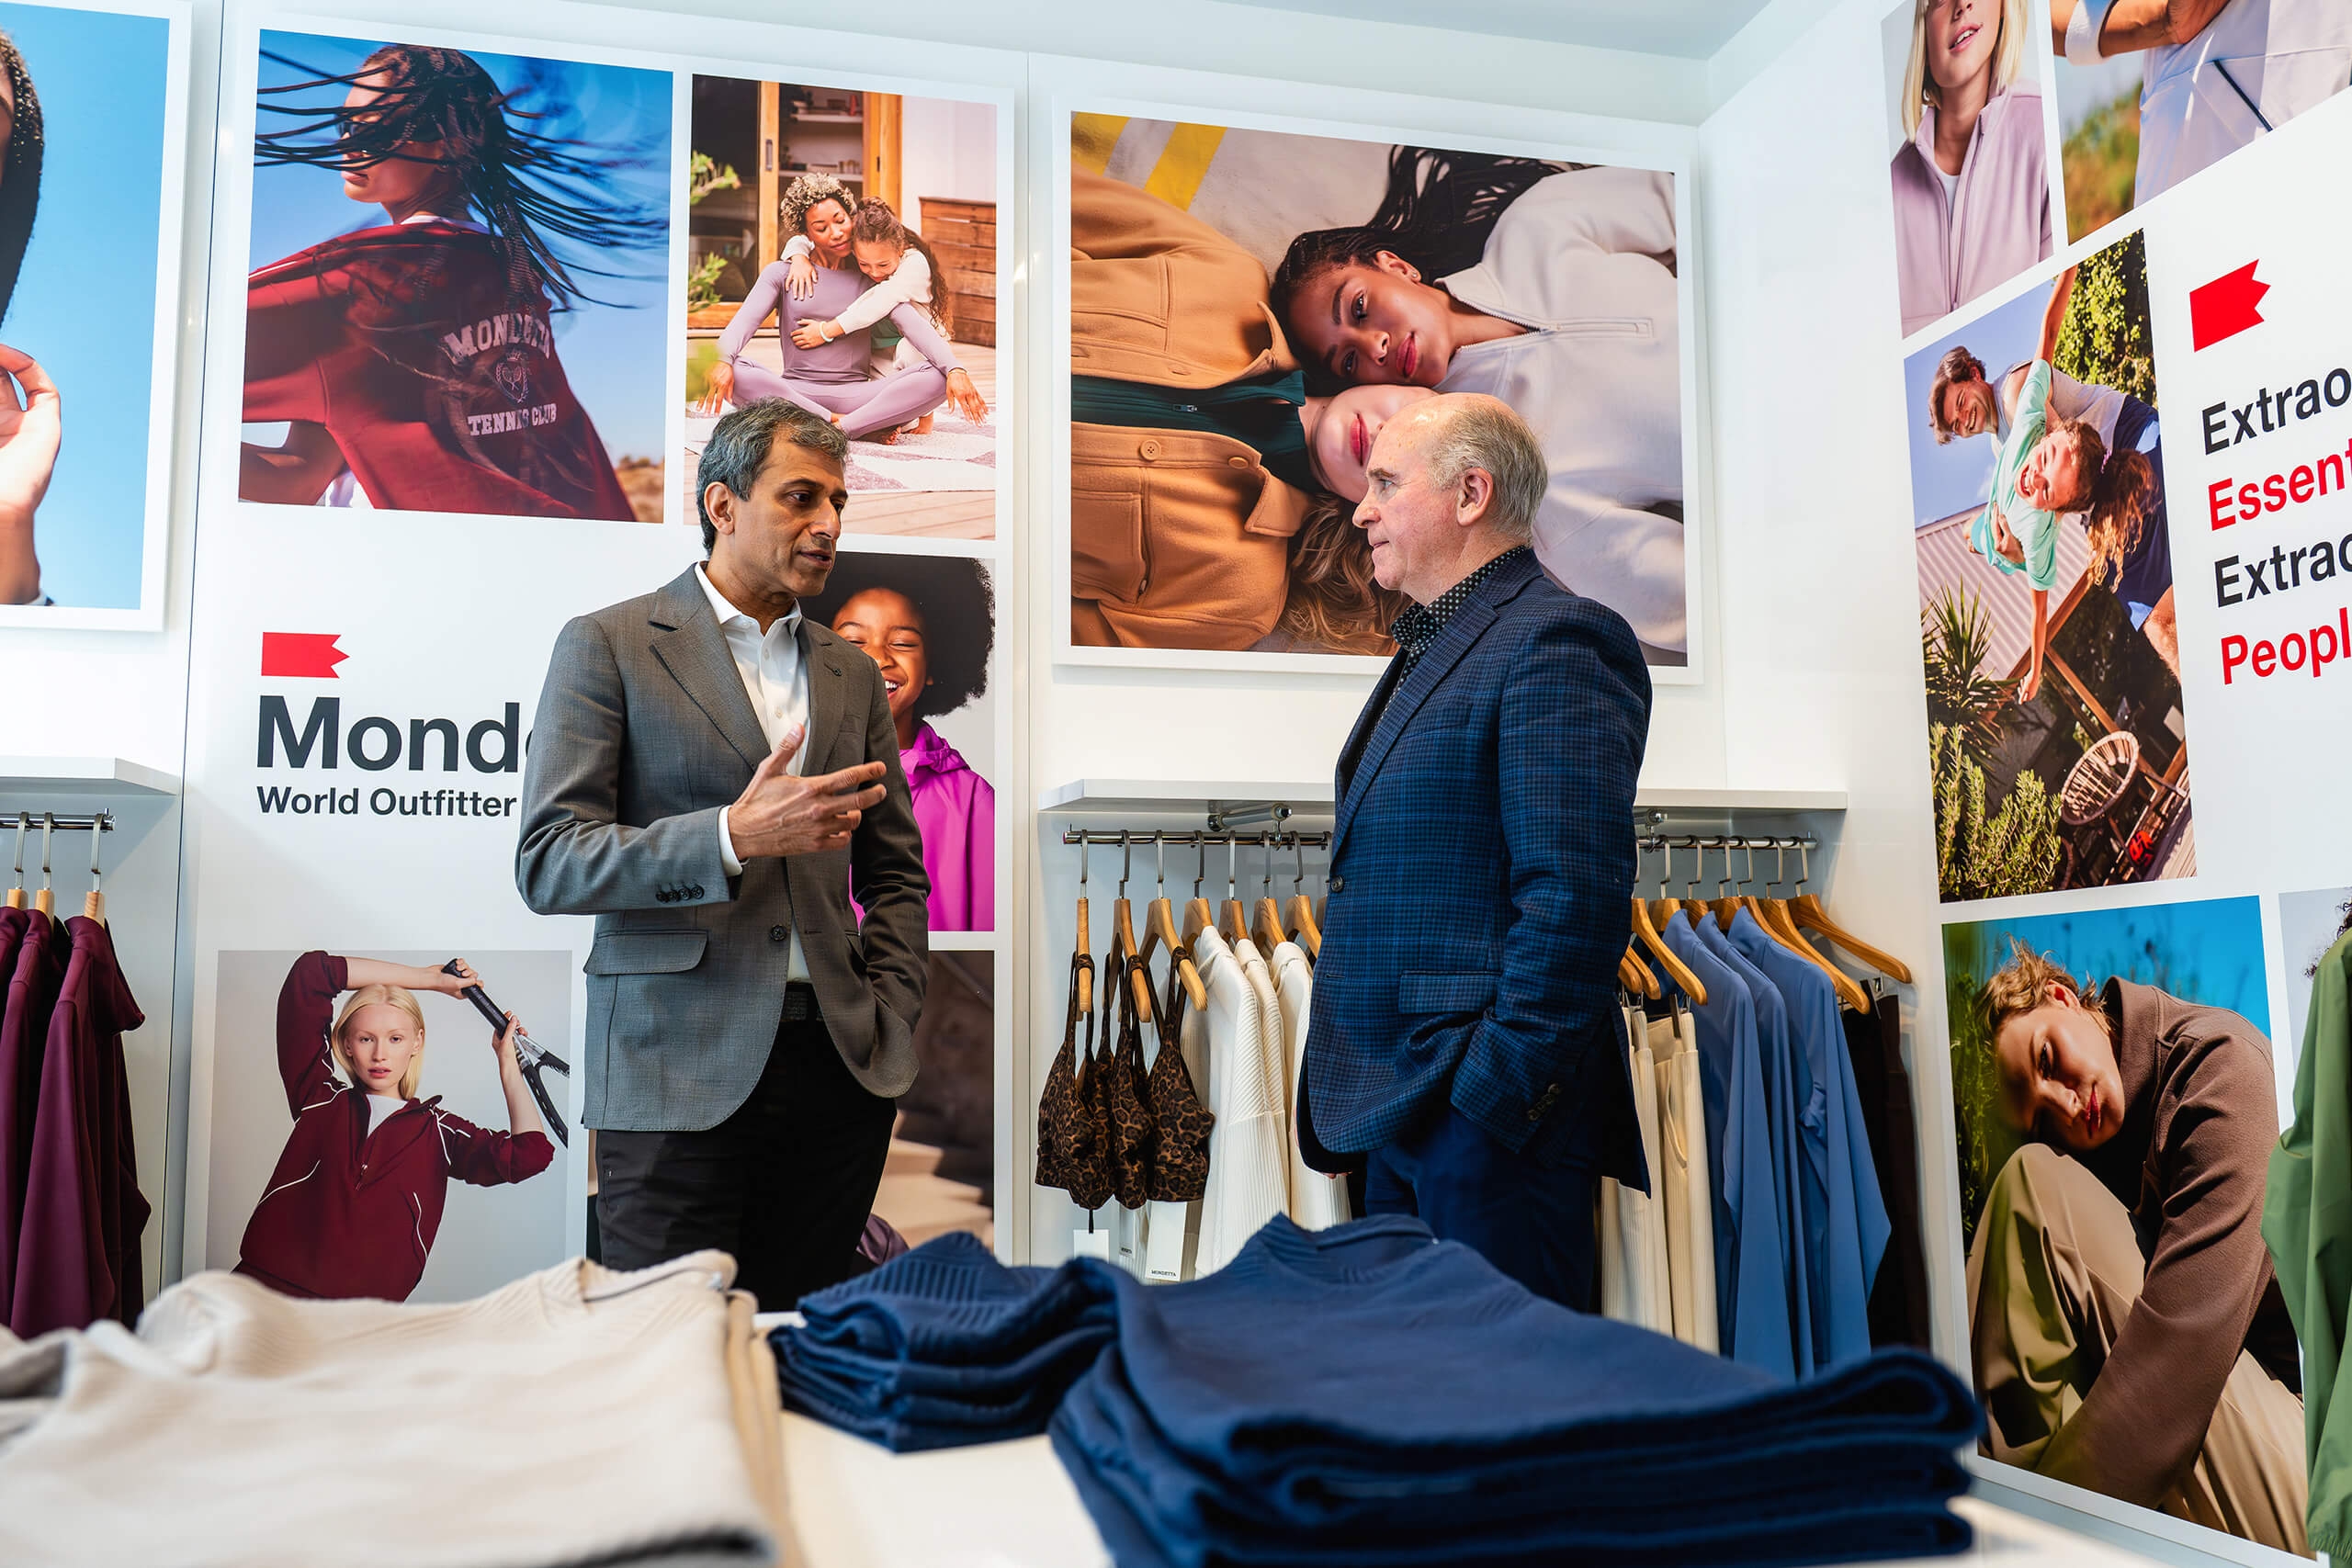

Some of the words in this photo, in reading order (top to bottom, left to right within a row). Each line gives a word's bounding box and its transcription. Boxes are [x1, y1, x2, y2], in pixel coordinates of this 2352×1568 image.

[467, 408, 530, 436] TENNIS
[531, 402, 558, 426] CLUB
[2200, 367, 2352, 456] Extrao
[2221, 606, 2352, 686] Peopl
[256, 694, 533, 773] Mond
[256, 785, 359, 815] World
[369, 787, 517, 818] Outfitter
